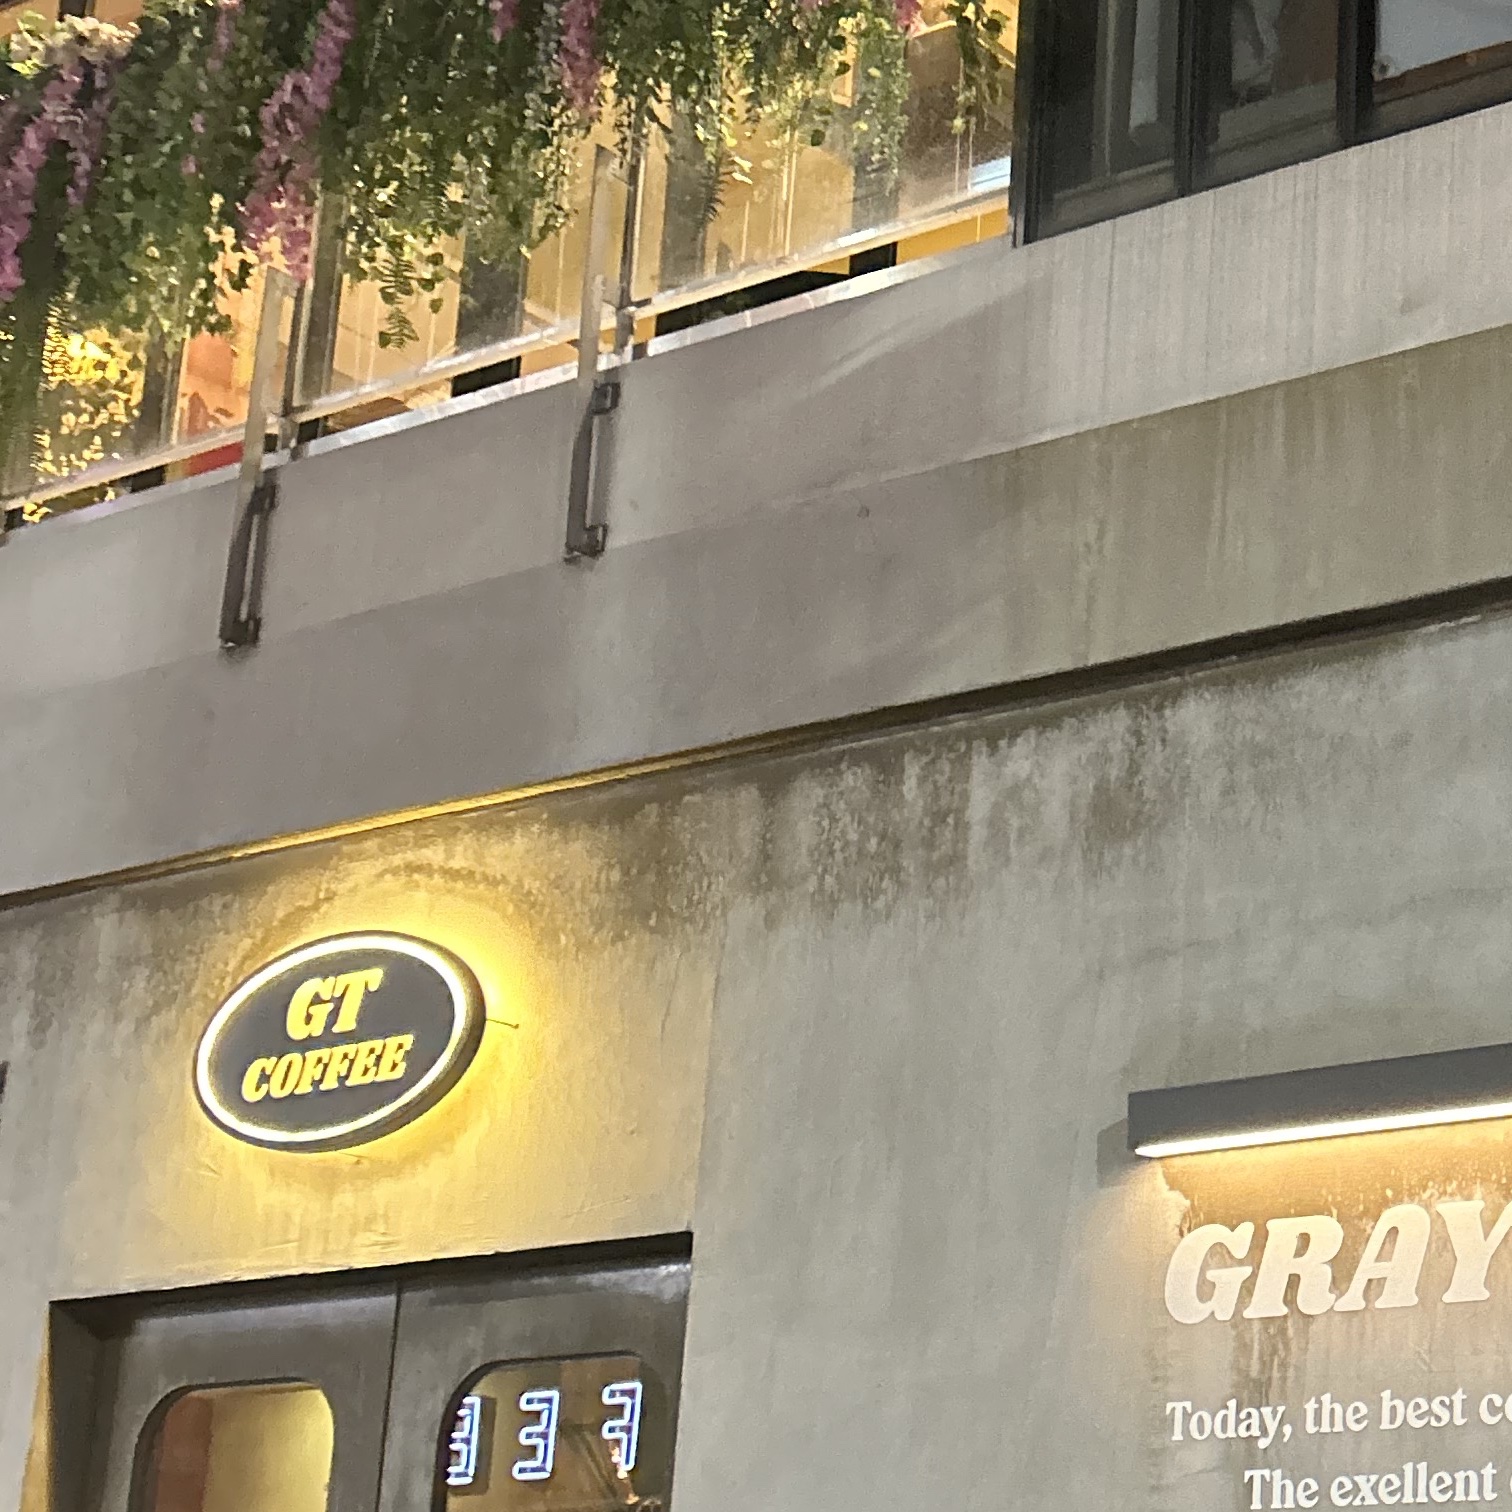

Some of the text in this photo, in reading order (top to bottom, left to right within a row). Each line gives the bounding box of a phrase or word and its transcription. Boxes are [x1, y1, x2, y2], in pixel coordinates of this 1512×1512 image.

[285, 967, 384, 1041] GT
[241, 1033, 415, 1103] COFFEE
[1166, 1399, 1293, 1449] Today,
[1304, 1393, 1369, 1434] the
[1379, 1389, 1468, 1430] best
[1244, 1468, 1320, 1510] The
[1329, 1461, 1498, 1507] exellent
